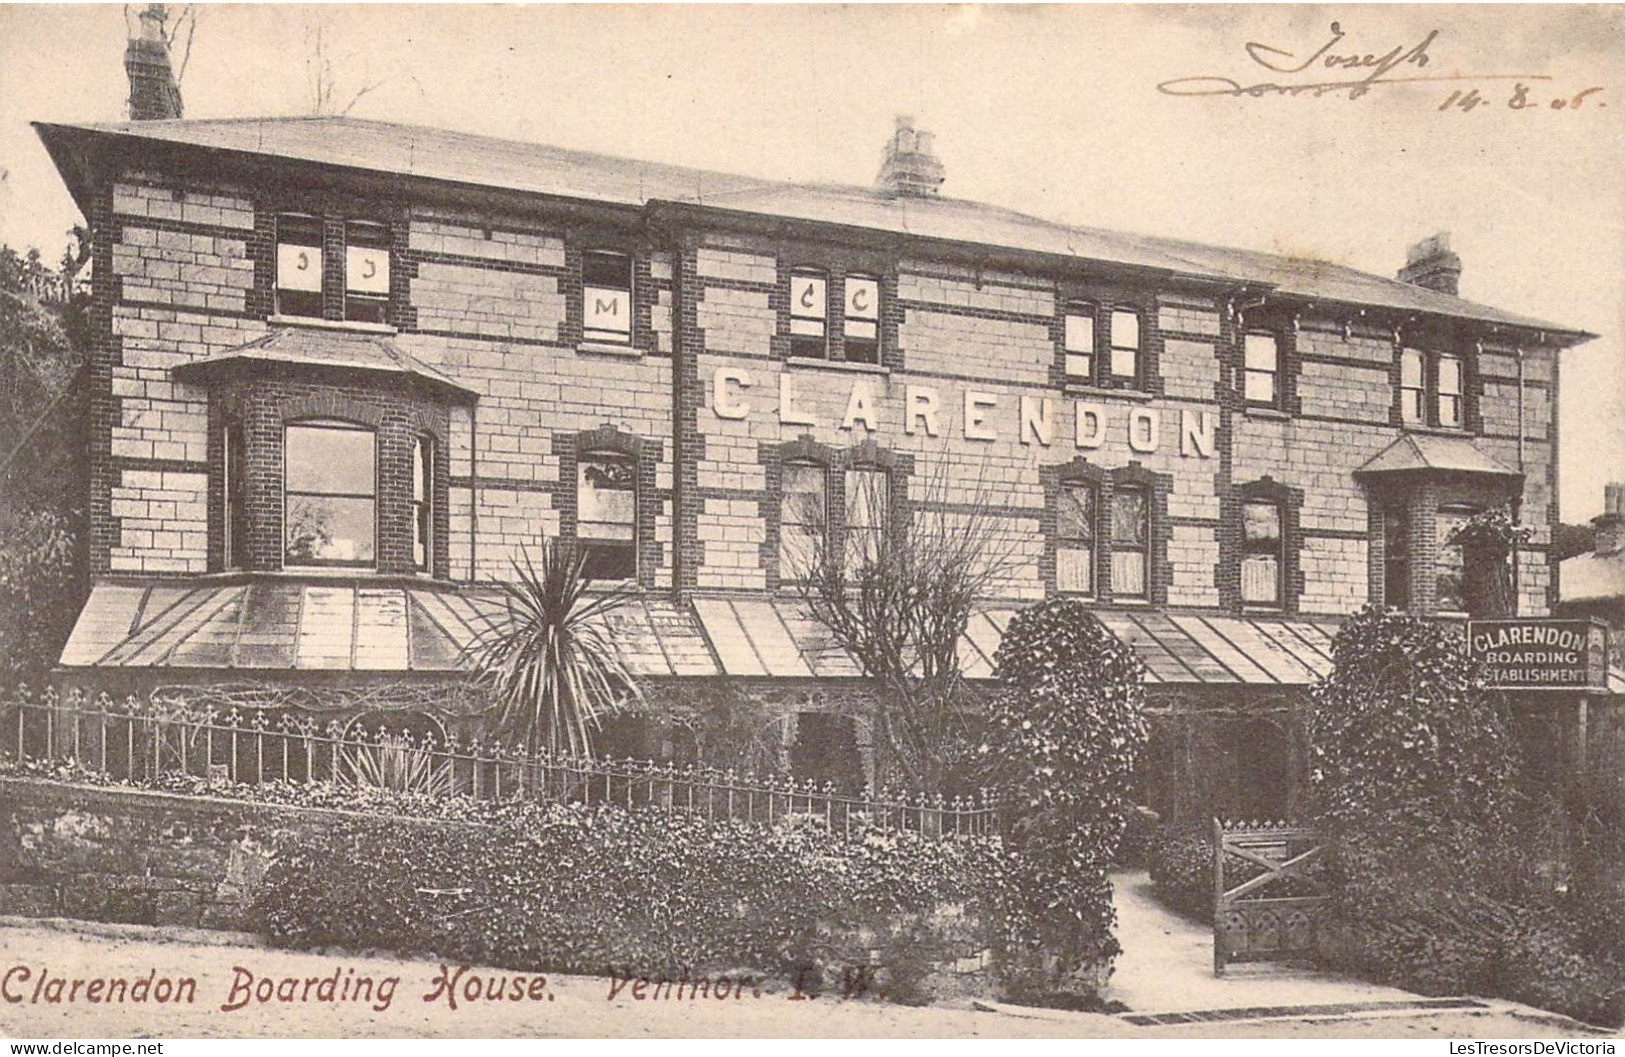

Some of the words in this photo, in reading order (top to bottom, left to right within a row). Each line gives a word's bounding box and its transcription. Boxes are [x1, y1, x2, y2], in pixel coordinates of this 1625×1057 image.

[595, 298, 618, 316] M
[713, 366, 1217, 458] CLARENDON
[1474, 627, 1586, 652] CLARENDON
[1486, 652, 1578, 664] BOARDING
